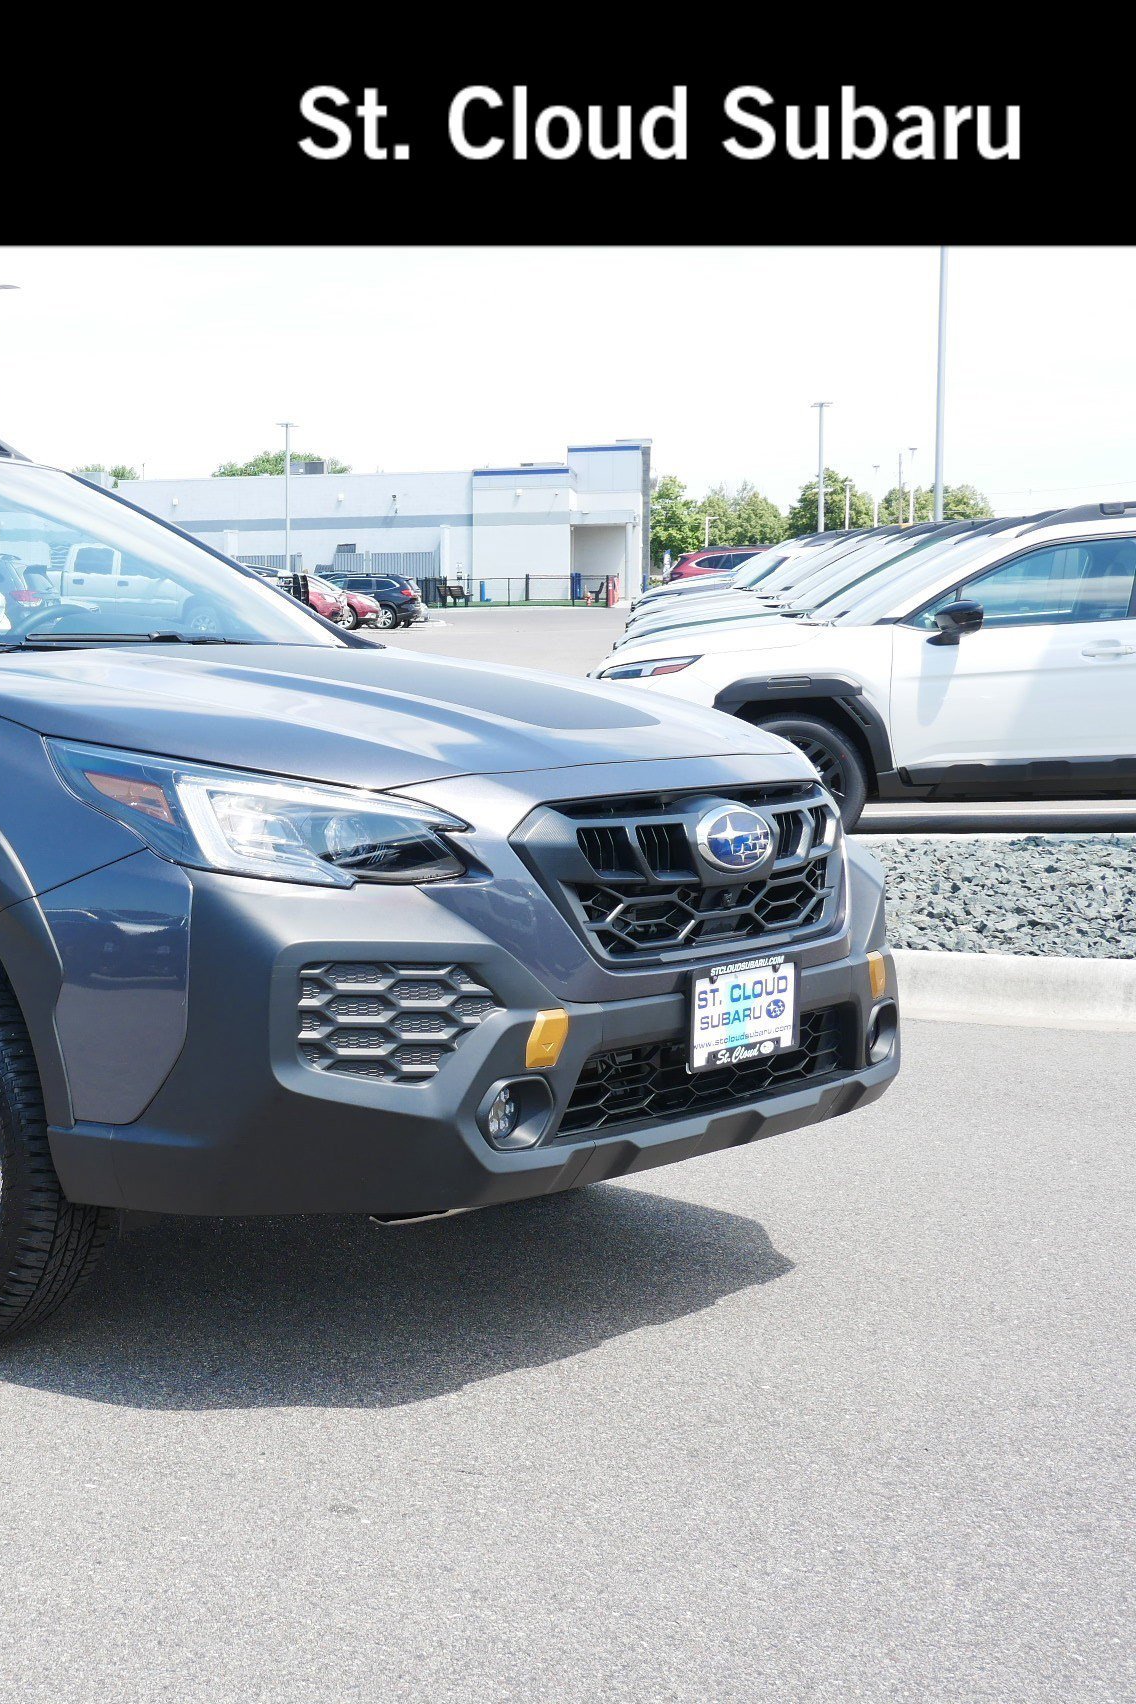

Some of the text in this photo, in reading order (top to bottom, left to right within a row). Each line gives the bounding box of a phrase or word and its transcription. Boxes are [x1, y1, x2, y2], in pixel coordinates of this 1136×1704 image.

[710, 955, 784, 976] STCLOUDSUBARU.COM
[697, 975, 788, 1010] ST. CLOUD
[699, 1004, 762, 1031] SUBARU
[694, 1024, 792, 1049] www.stcloudsubaru.com
[716, 1045, 760, 1065] St. Cloud
